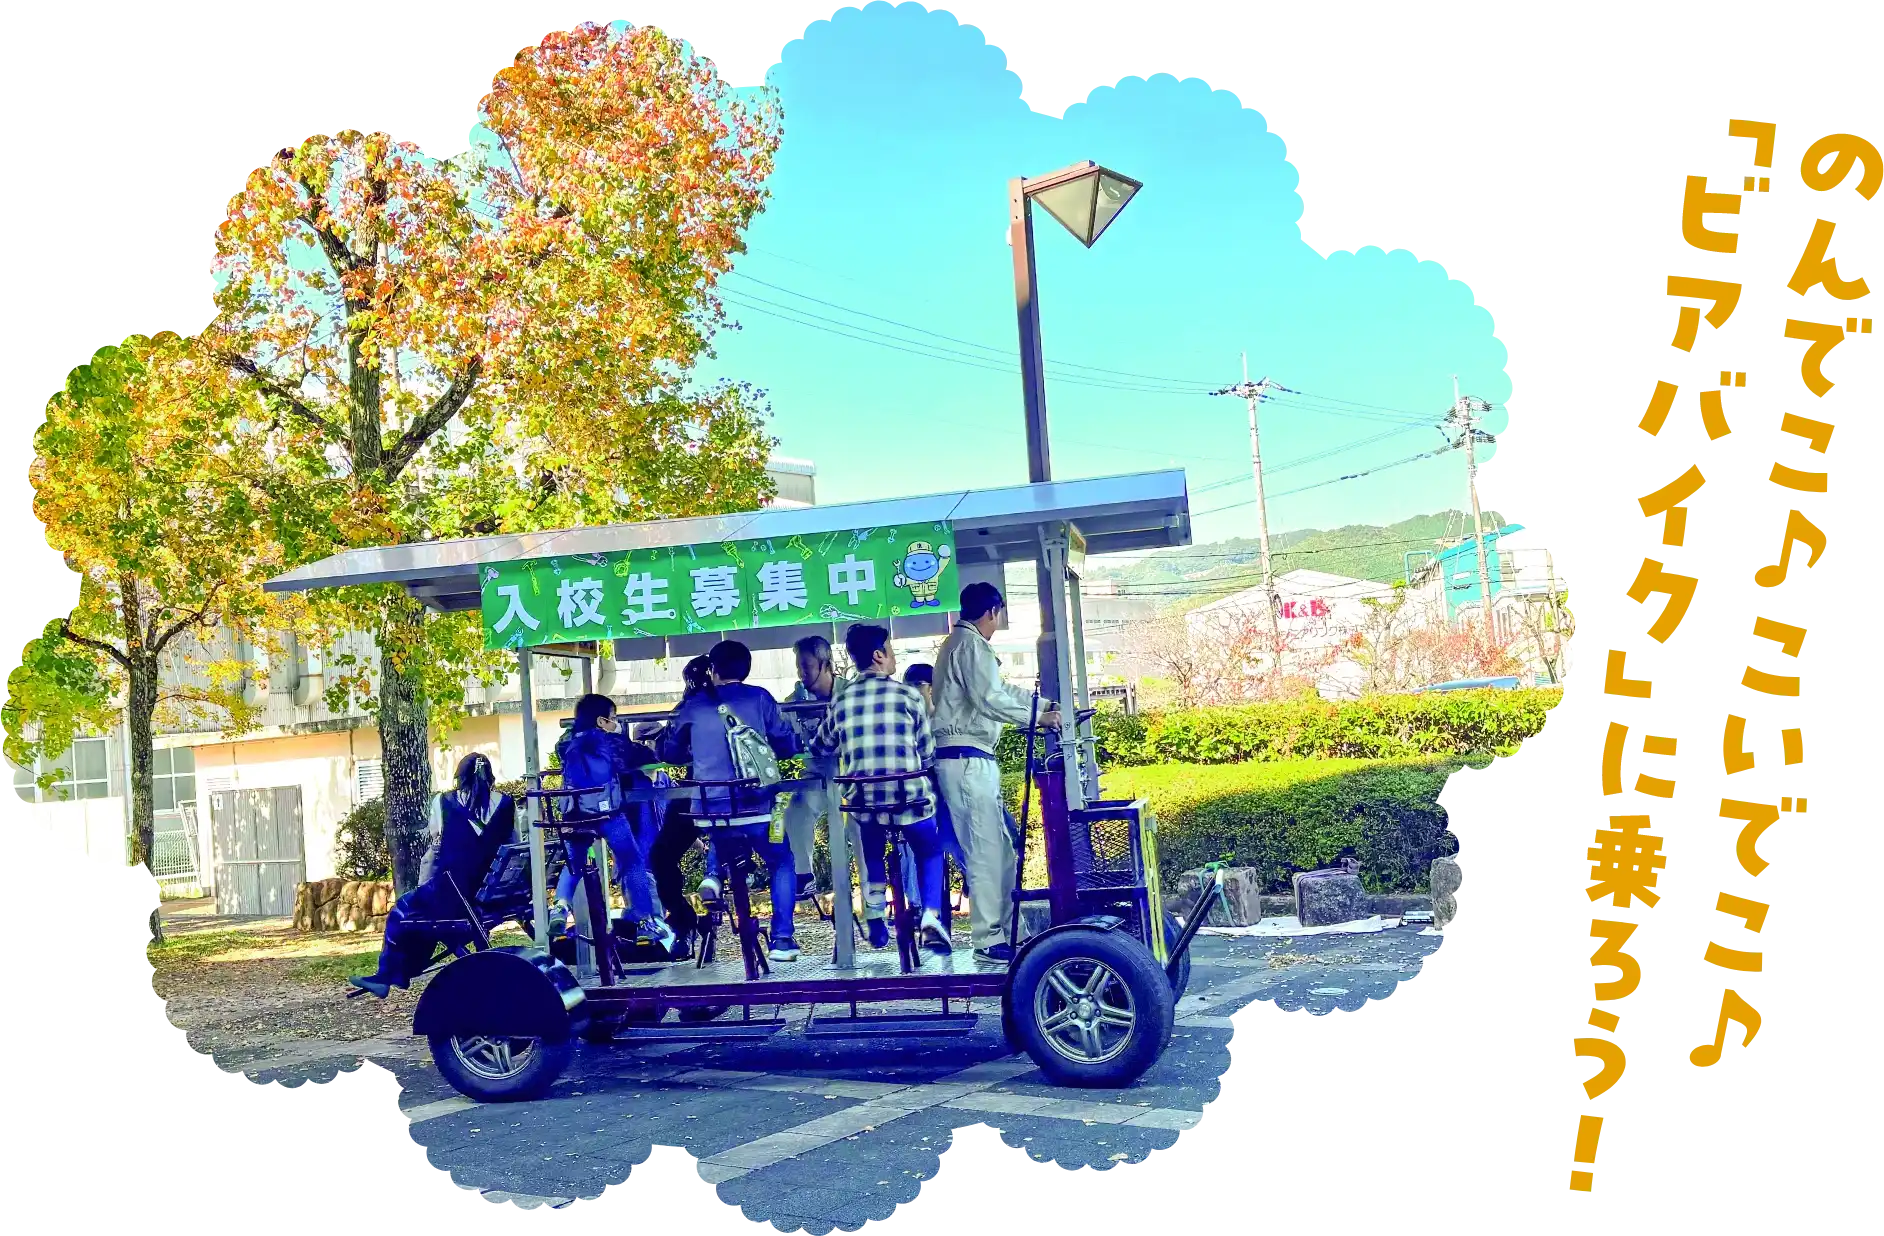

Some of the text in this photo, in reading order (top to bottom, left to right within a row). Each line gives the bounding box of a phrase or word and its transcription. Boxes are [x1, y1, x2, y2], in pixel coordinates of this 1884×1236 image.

[491, 552, 877, 635] 入校生募集中
